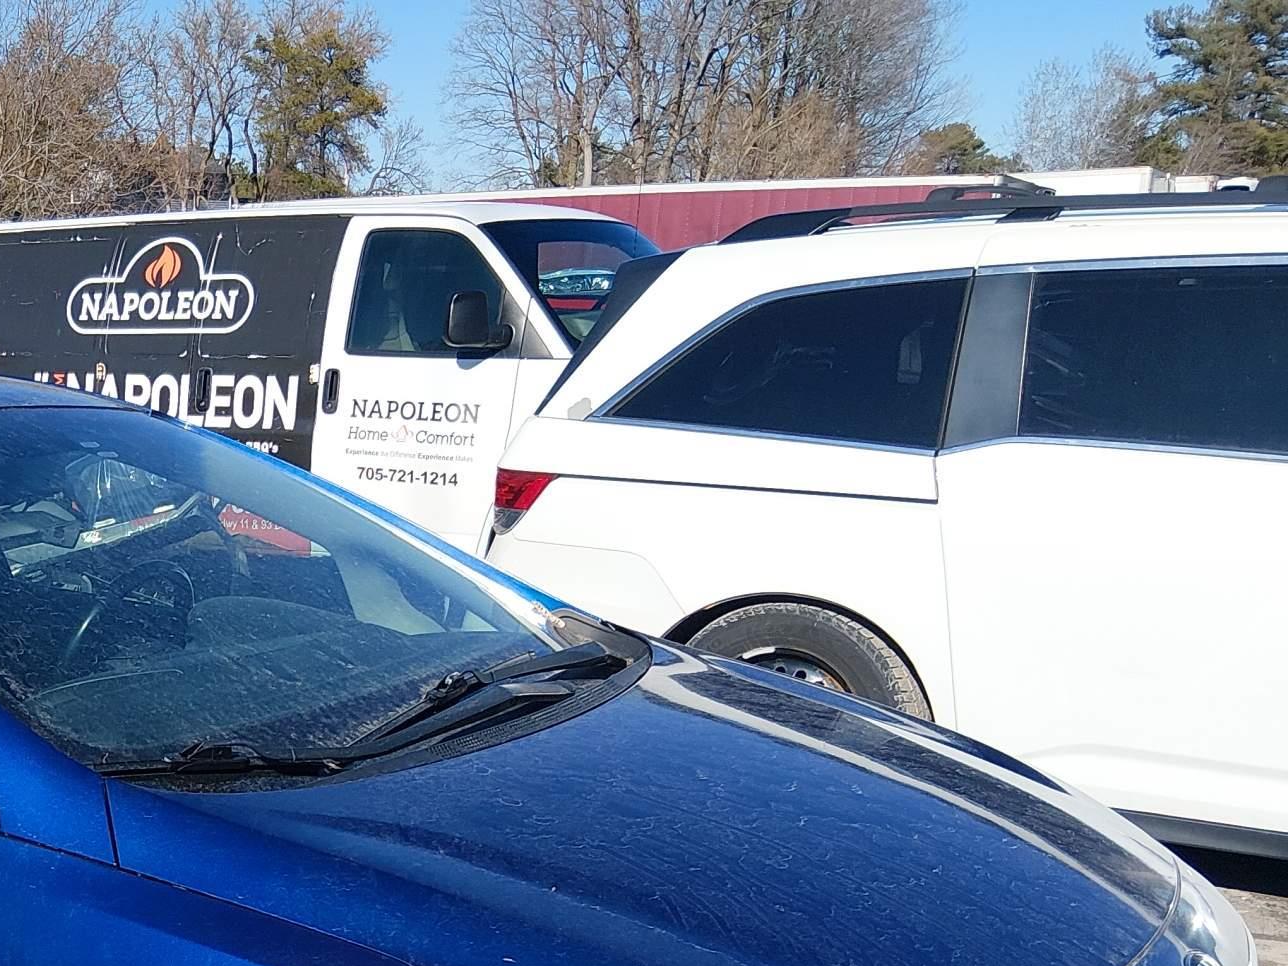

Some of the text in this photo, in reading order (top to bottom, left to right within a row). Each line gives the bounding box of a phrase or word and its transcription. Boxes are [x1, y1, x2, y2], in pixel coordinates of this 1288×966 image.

[78, 289, 239, 321] NAPOLEON
[350, 399, 481, 424] NAPOLEON
[347, 425, 475, 447] Home Comfort
[345, 447, 379, 457] Experience
[417, 452, 454, 462] Experience
[356, 466, 459, 487] 705-721-1214
[239, 519, 250, 530] 11
[251, 519, 259, 530] &
[260, 520, 273, 530] 93
